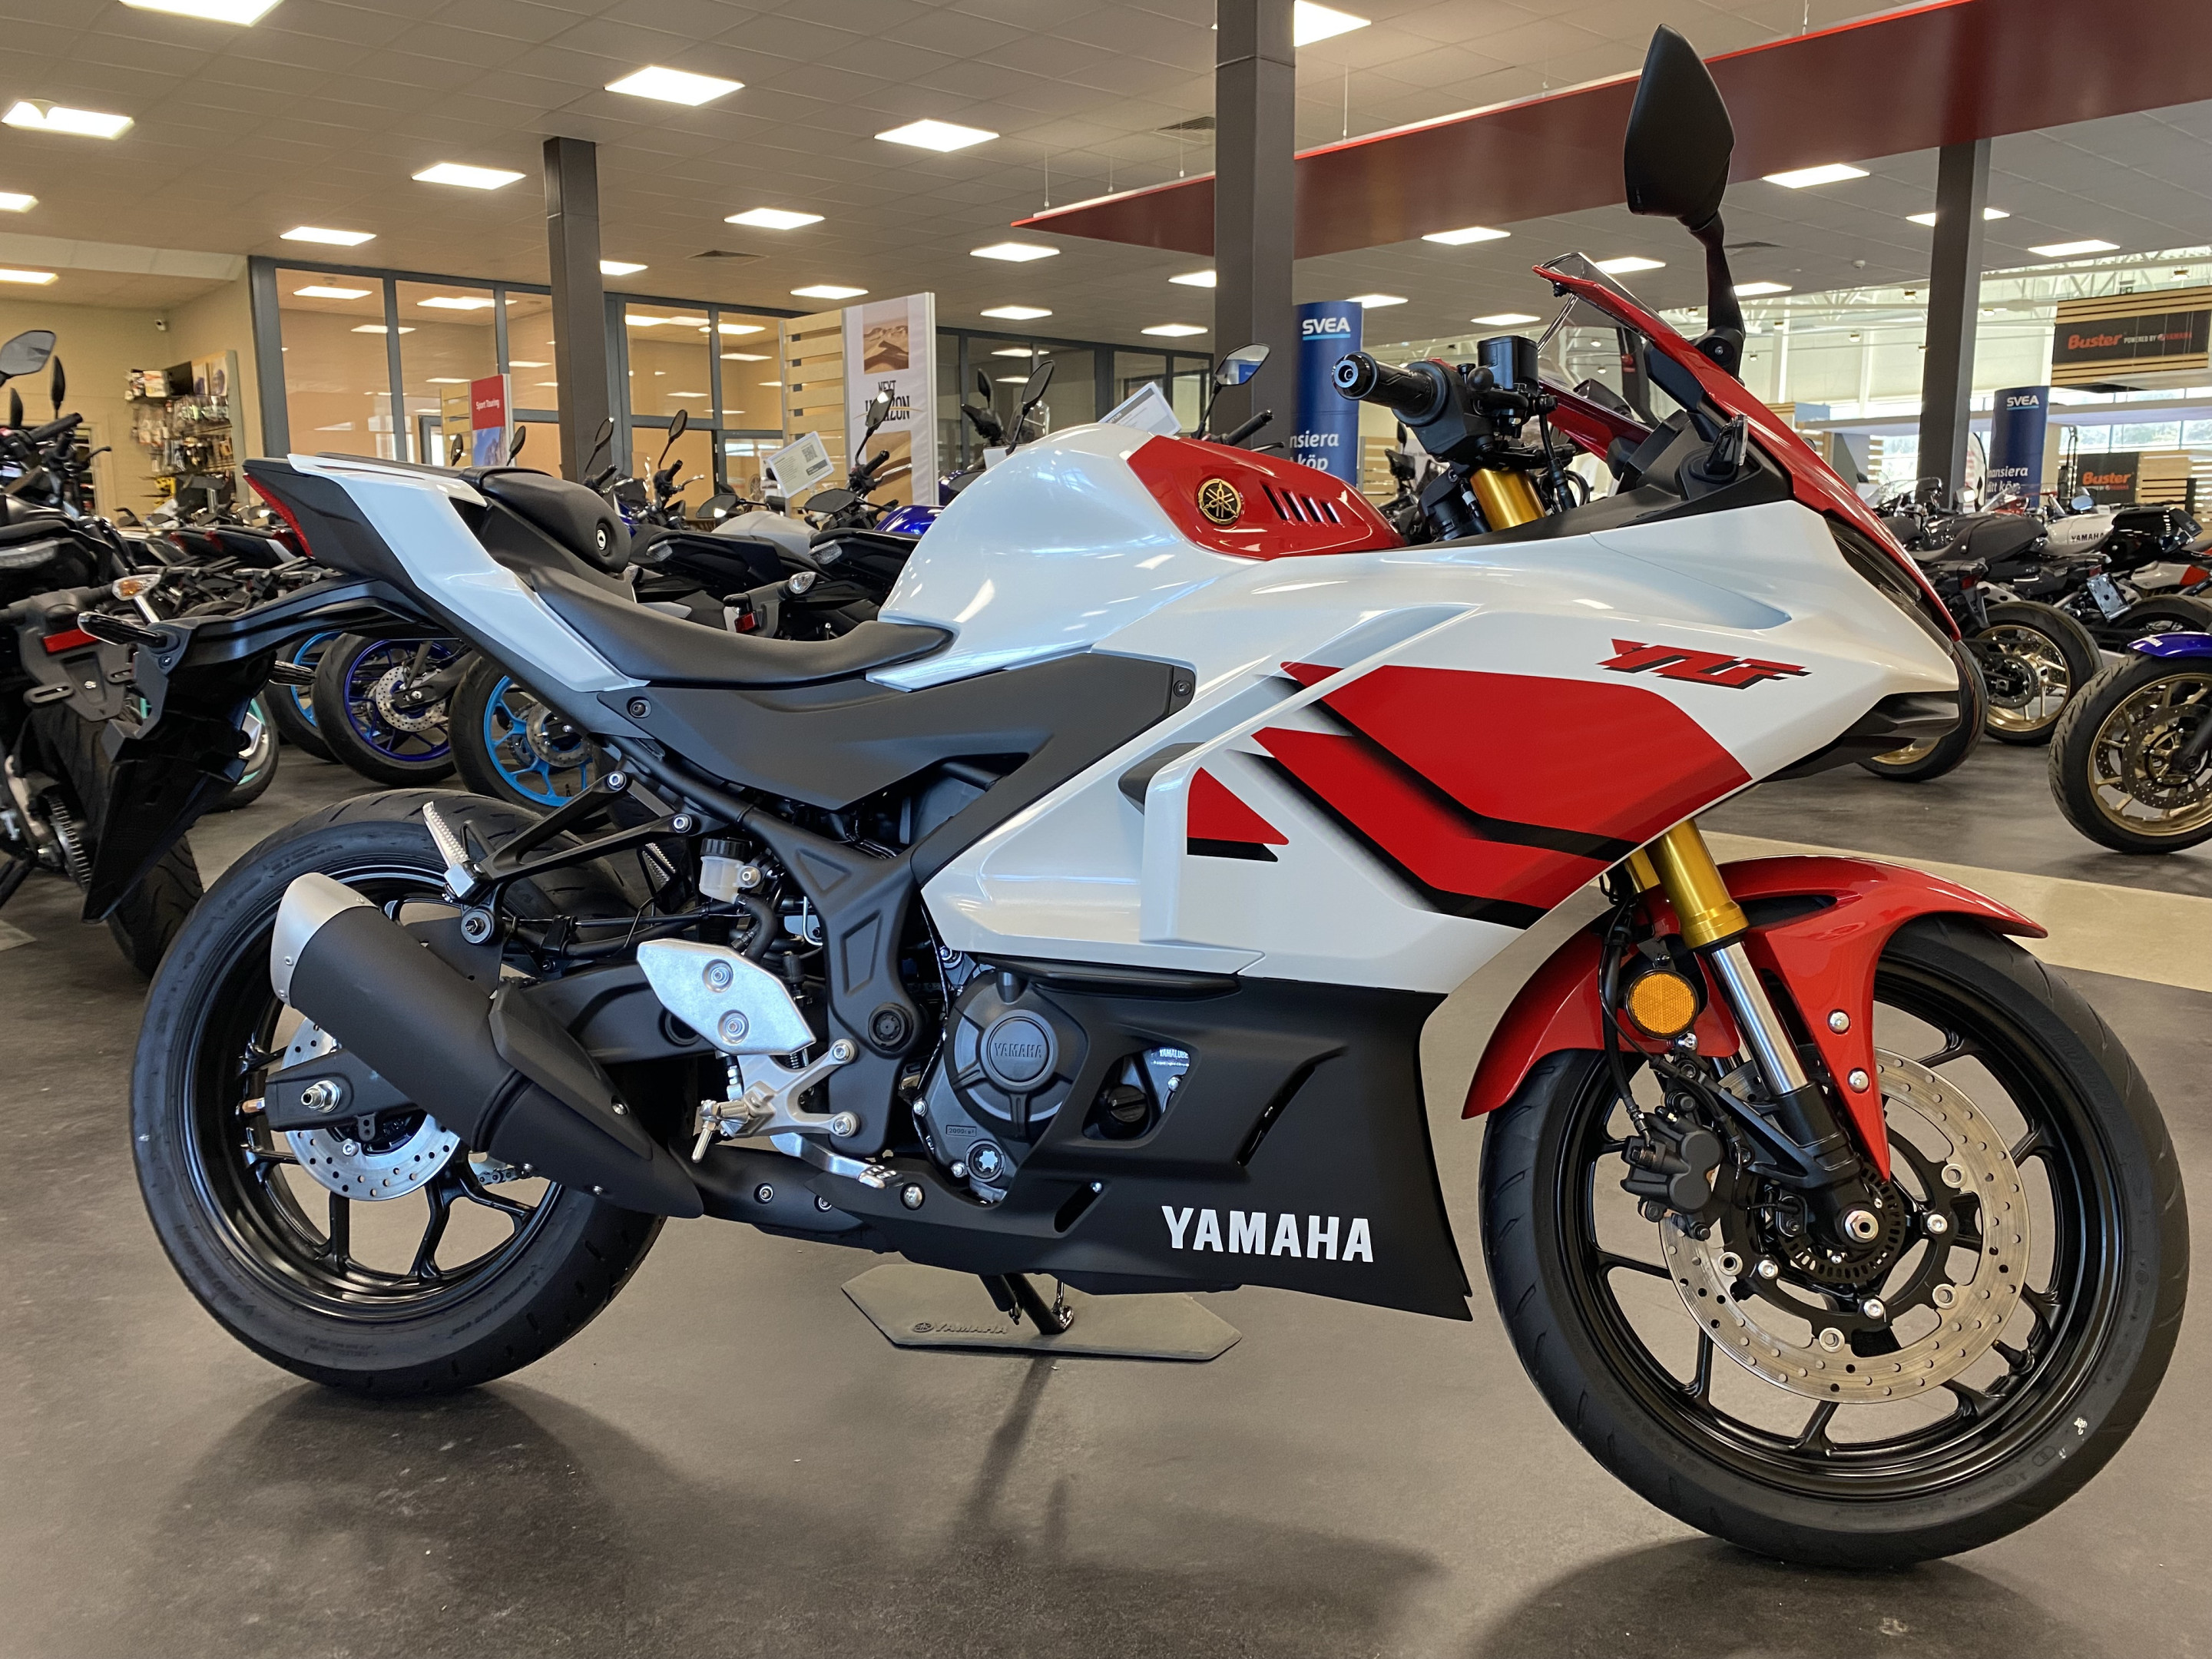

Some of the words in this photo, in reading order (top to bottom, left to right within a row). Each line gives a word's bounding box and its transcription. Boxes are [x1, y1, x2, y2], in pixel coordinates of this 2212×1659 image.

[1302, 317, 1351, 335] SVEA
[2068, 334, 2123, 349] Buster
[2006, 396, 2039, 407] SVEA
[2082, 472, 2132, 485] Buster
[2071, 532, 2104, 543] YAMAHA
[994, 1042, 1042, 1058] YAMAHA
[1161, 1205, 1373, 1263] YAMAHA
